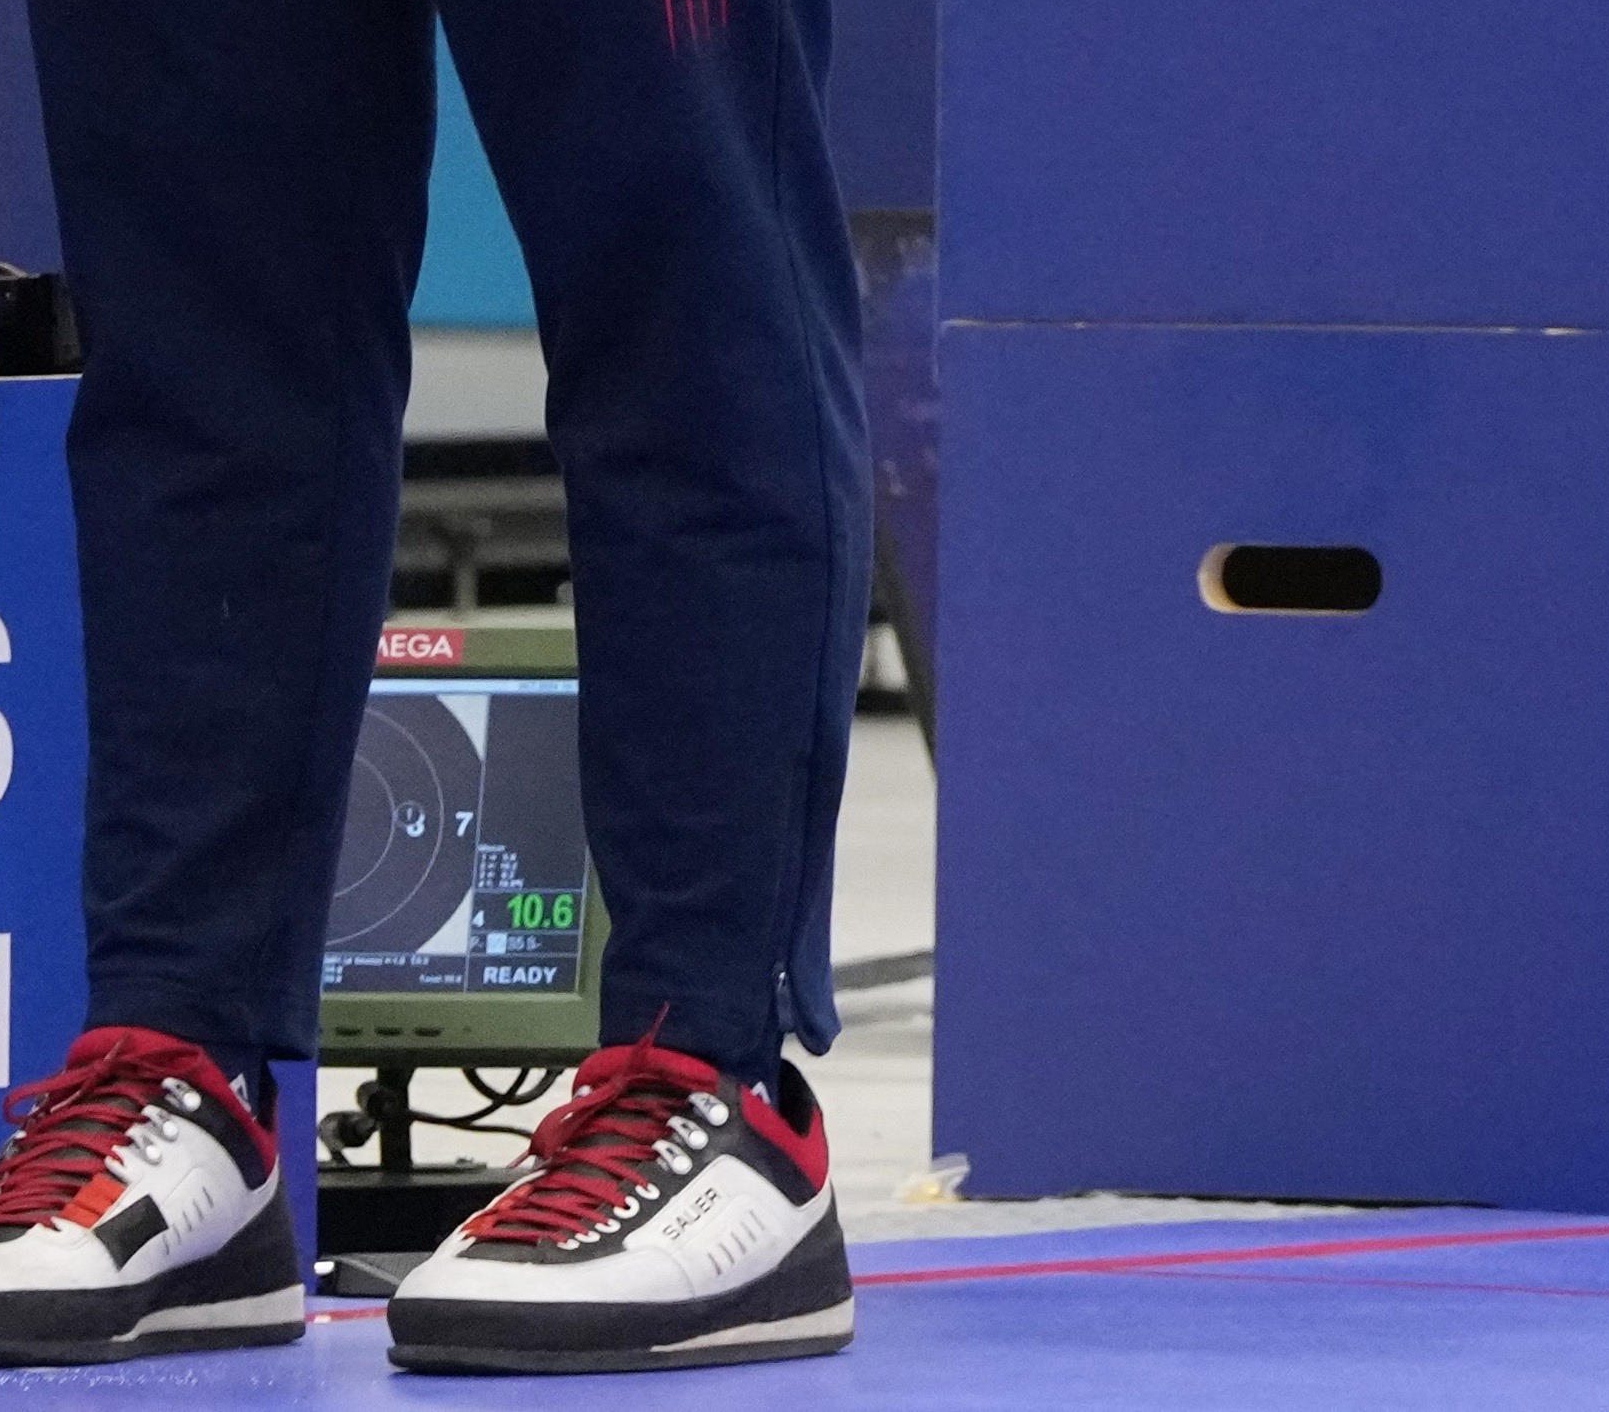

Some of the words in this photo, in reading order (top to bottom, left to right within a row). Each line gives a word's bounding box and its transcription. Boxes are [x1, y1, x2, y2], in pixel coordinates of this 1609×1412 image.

[455, 811, 474, 837] 7
[507, 892, 574, 929] 10.6
[482, 966, 557, 985] READY
[662, 1187, 722, 1241] SAUER
